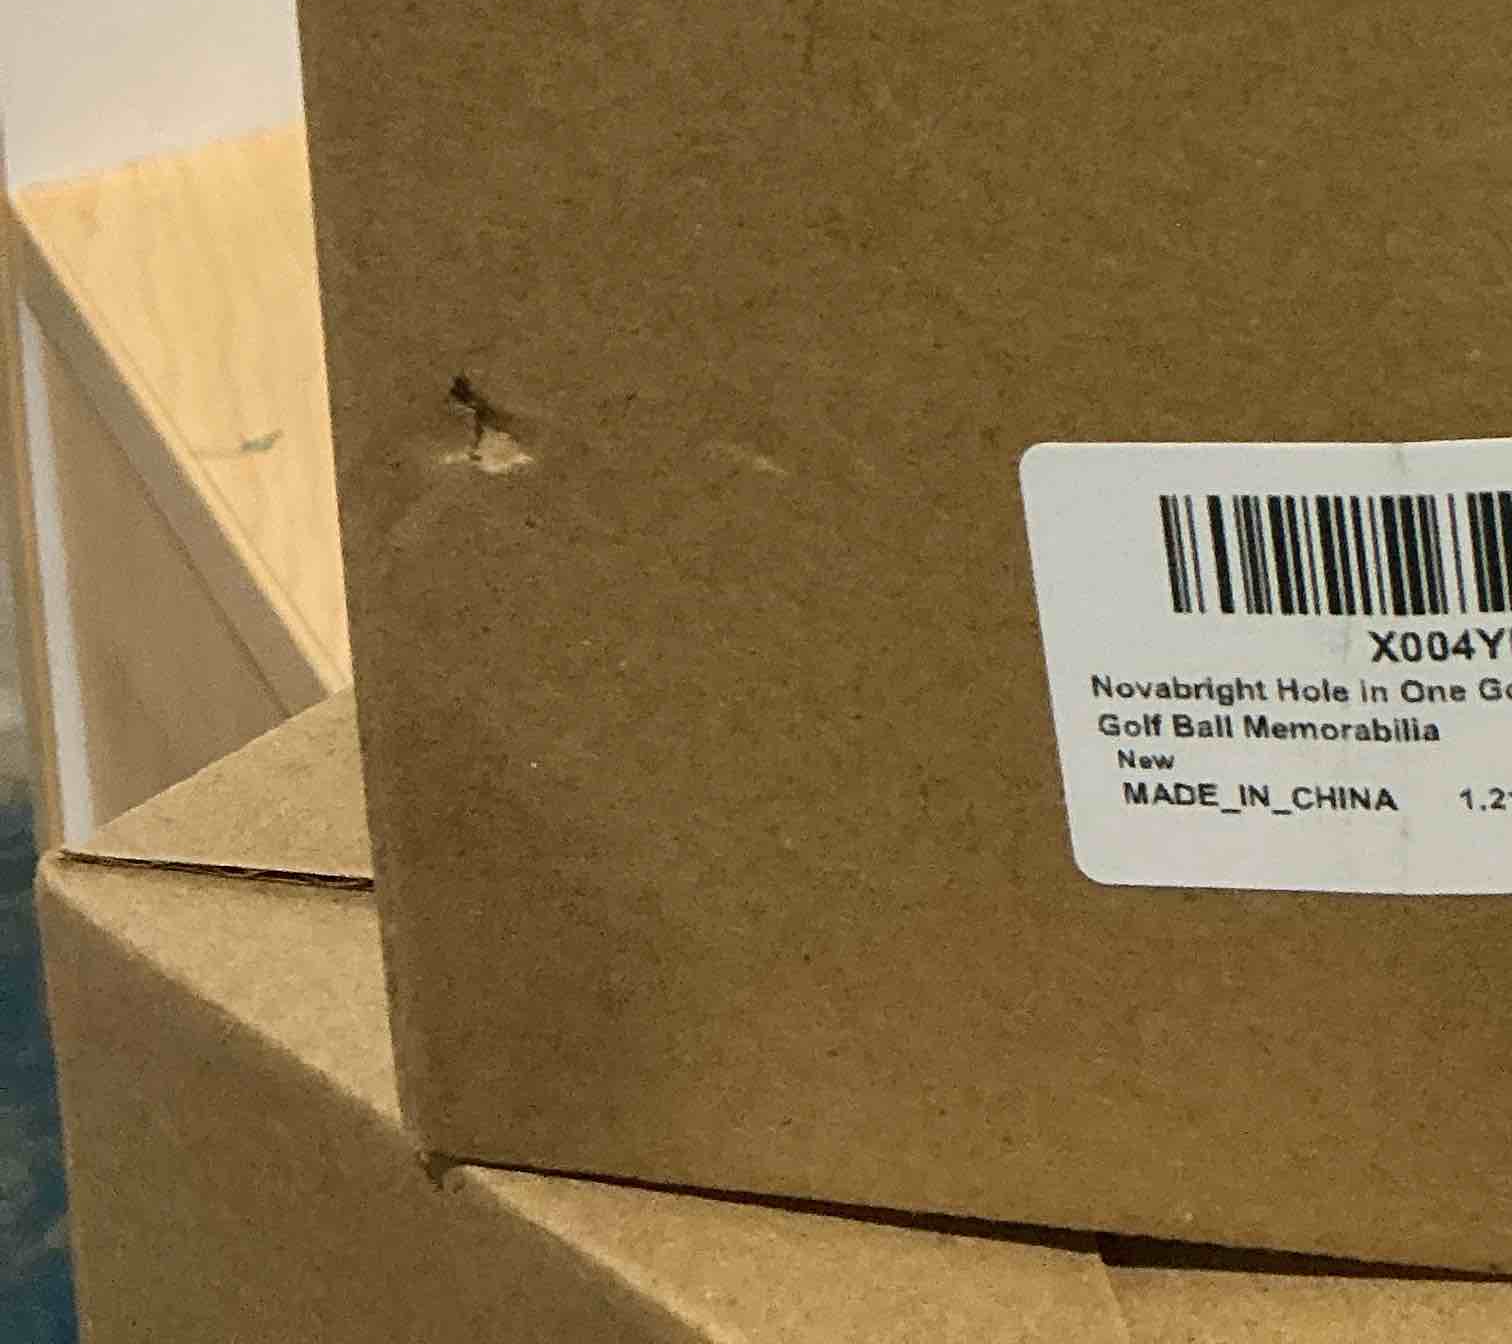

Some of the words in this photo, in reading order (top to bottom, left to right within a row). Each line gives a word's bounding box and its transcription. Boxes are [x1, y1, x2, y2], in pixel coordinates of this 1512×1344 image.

[1091, 673, 1267, 706] Novabright
[1277, 678, 1349, 703] Hole
[1360, 678, 1388, 703] in
[1401, 679, 1466, 703] One
[1098, 713, 1162, 738] Golf
[1173, 714, 1233, 739] Ball
[1244, 714, 1441, 742] Memorabilia
[1117, 749, 1174, 770] New
[1123, 782, 1398, 814] MADE_IN_CHINA
